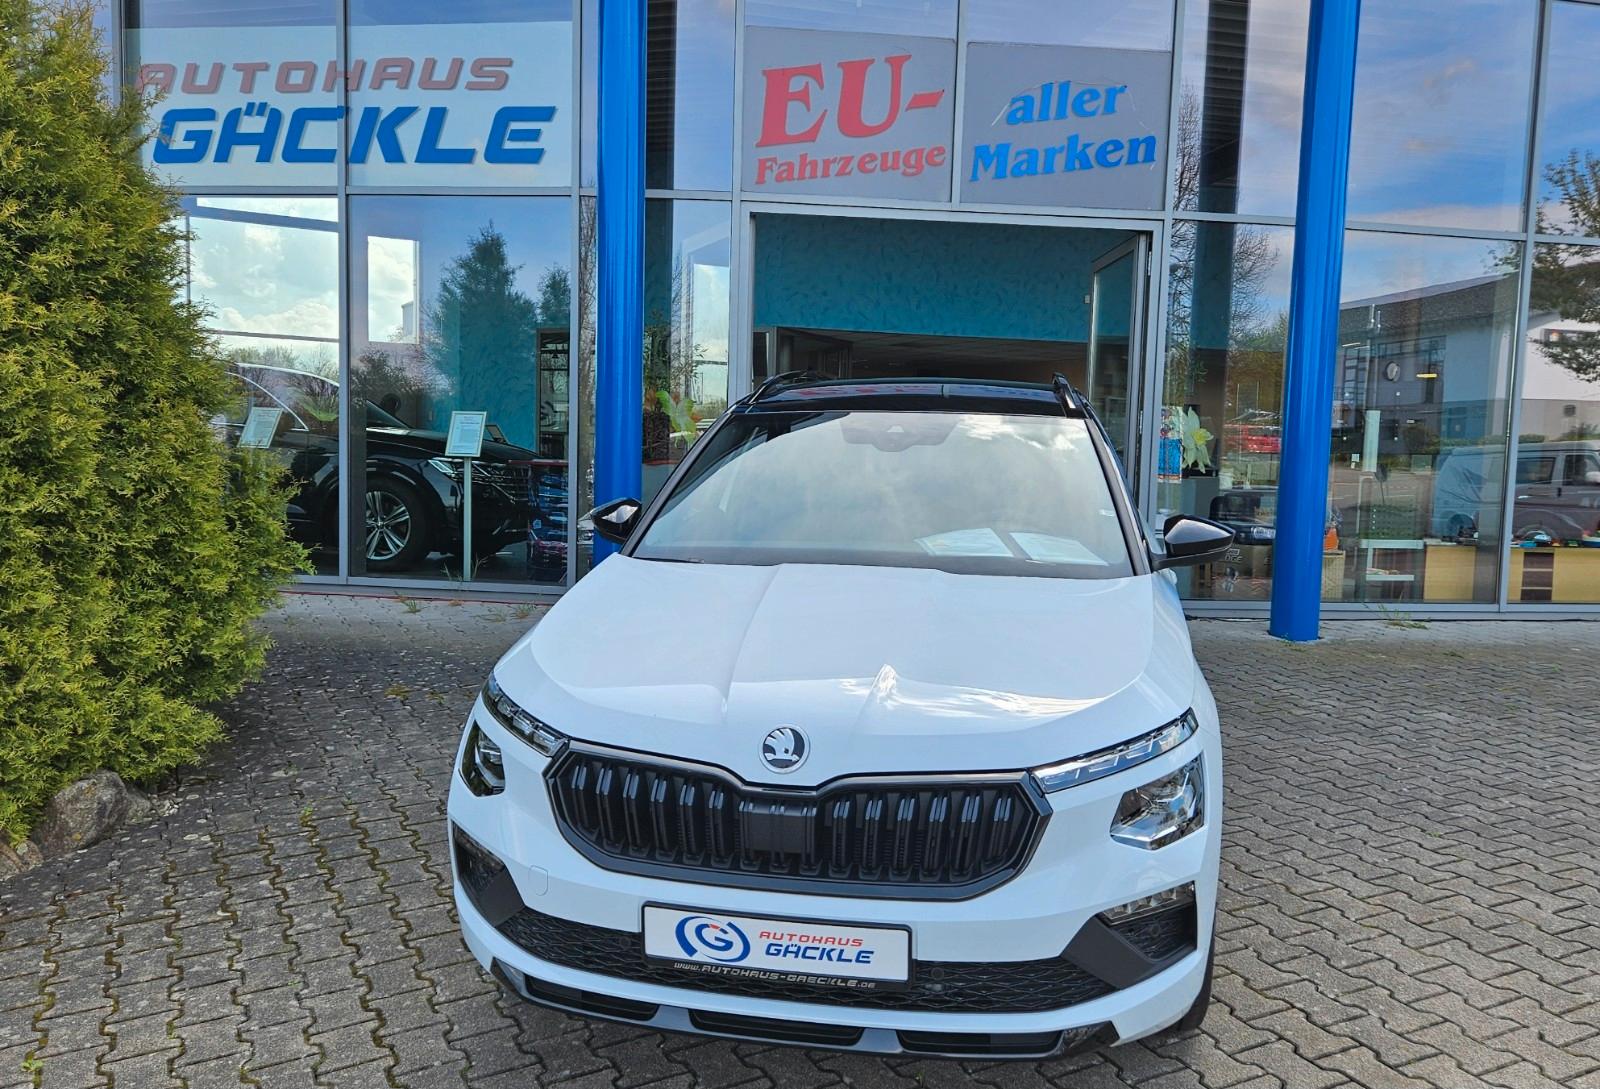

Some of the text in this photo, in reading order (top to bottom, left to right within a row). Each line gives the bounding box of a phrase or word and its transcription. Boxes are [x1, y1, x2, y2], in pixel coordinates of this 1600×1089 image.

[136, 57, 512, 94] AUTOHAUS
[755, 54, 944, 148] EU-
[1006, 80, 1127, 125] aller
[152, 102, 556, 164] GÄCKLE
[755, 145, 946, 185] Fahrzeuge
[968, 134, 1156, 182] Marken
[759, 931, 864, 947] AUTOHAUS
[765, 943, 875, 964] GÄCKLE
